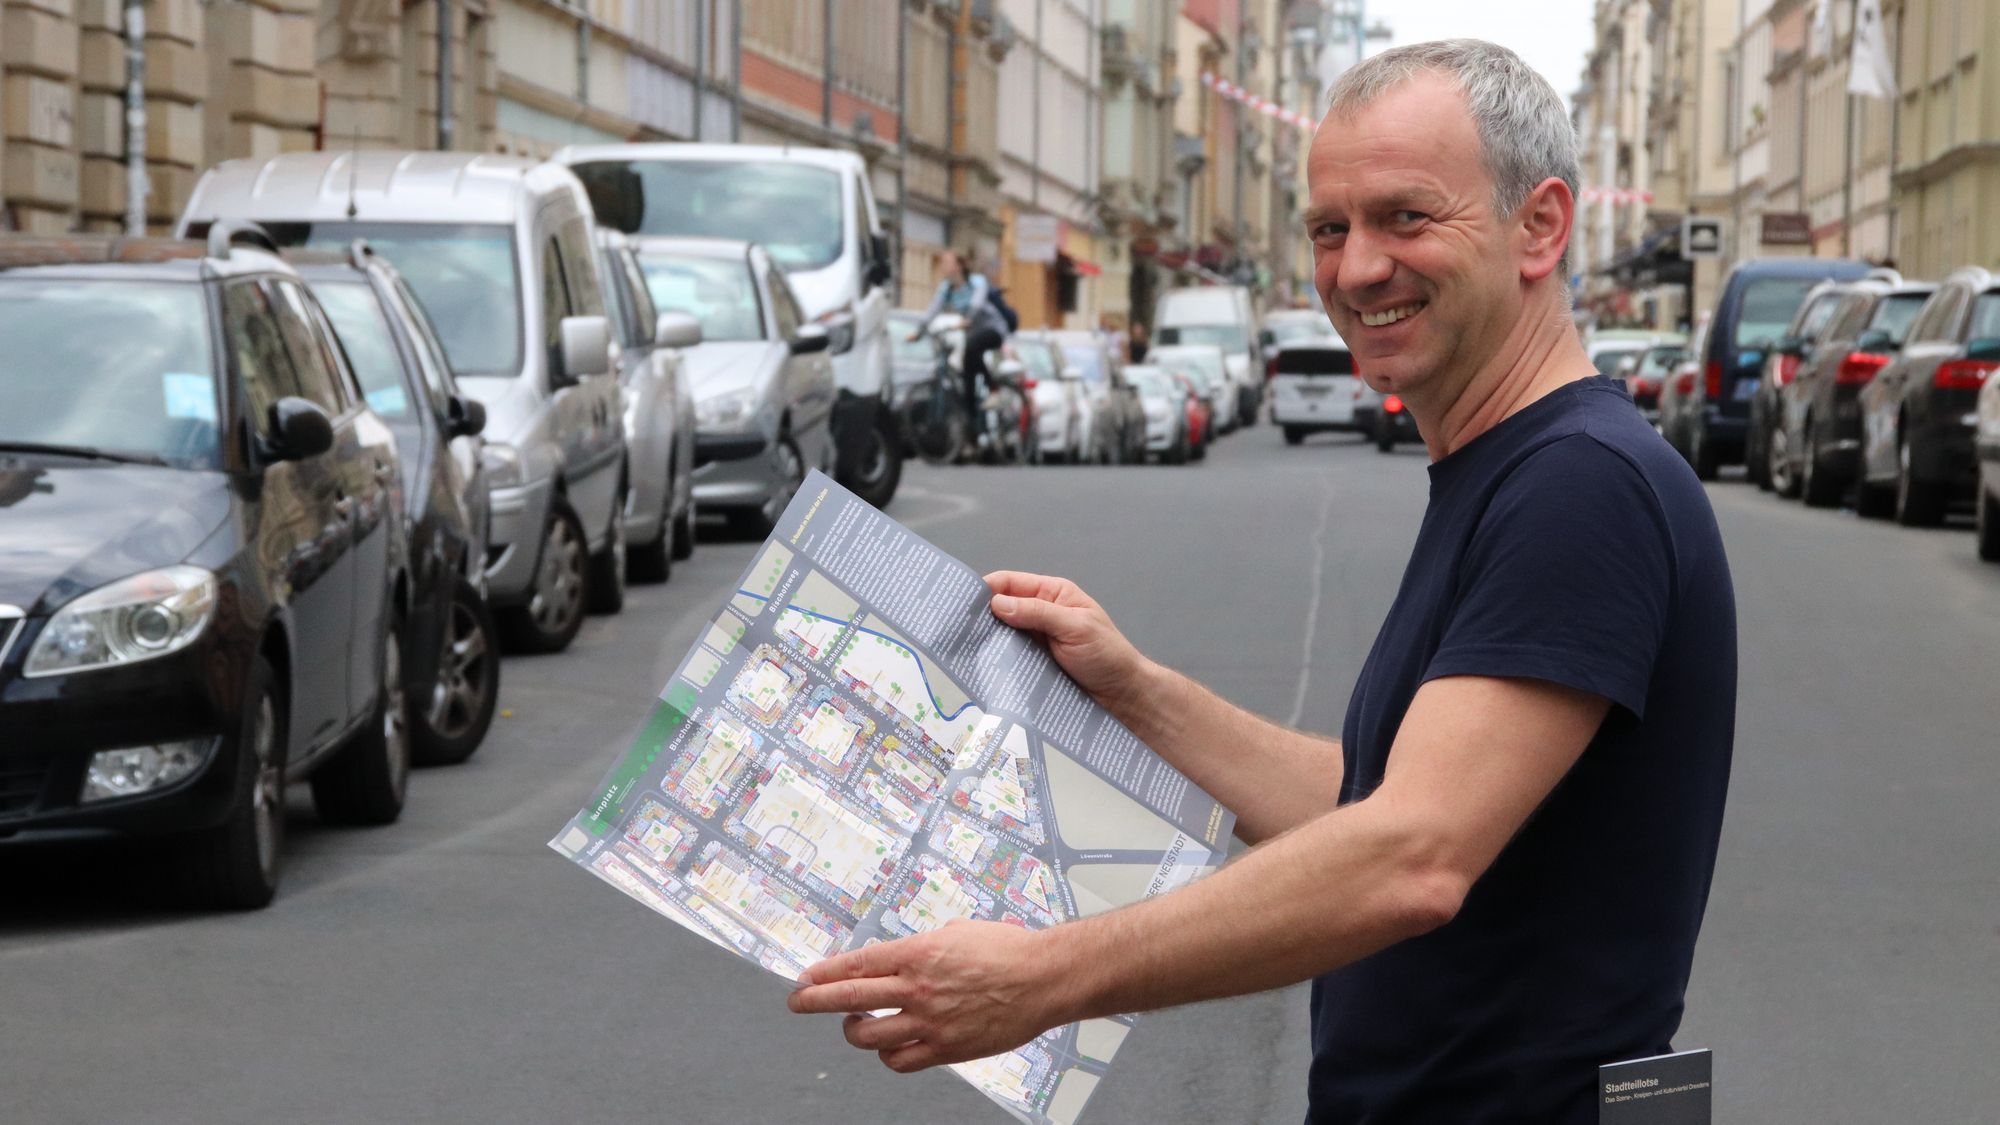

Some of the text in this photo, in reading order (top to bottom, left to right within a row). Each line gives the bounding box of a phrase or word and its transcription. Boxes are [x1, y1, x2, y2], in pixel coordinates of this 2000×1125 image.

[765, 567, 802, 614] Bischofsweg
[822, 610, 866, 668] Hohnsteiner Str.
[775, 641, 838, 688] Prießnitzstraße
[667, 705, 705, 752] Bischofsweg
[719, 698, 787, 750] Kamenzer Straße
[776, 701, 801, 732] Sebnitzer
[845, 729, 885, 788] Schönfelder Straße
[892, 726, 951, 774] Prießnitzstraße
[975, 727, 1007, 771] Prießnitzstr.
[724, 767, 756, 807] Sebnitzer
[814, 767, 882, 819] Kamenzer Straße
[879, 769, 919, 801] Talstraße
[961, 812, 1034, 854] Pulsnitzer Straße
[1158, 833, 1187, 878] NEUSTADT
[746, 851, 810, 897] Görlitzer Straße
[946, 859, 1029, 919] Martin-Luther-Straße
[1061, 884, 1074, 915] Bautzner
[1041, 1068, 1059, 1096] Straße
[1605, 1078, 1658, 1094] Stadtteillotse
